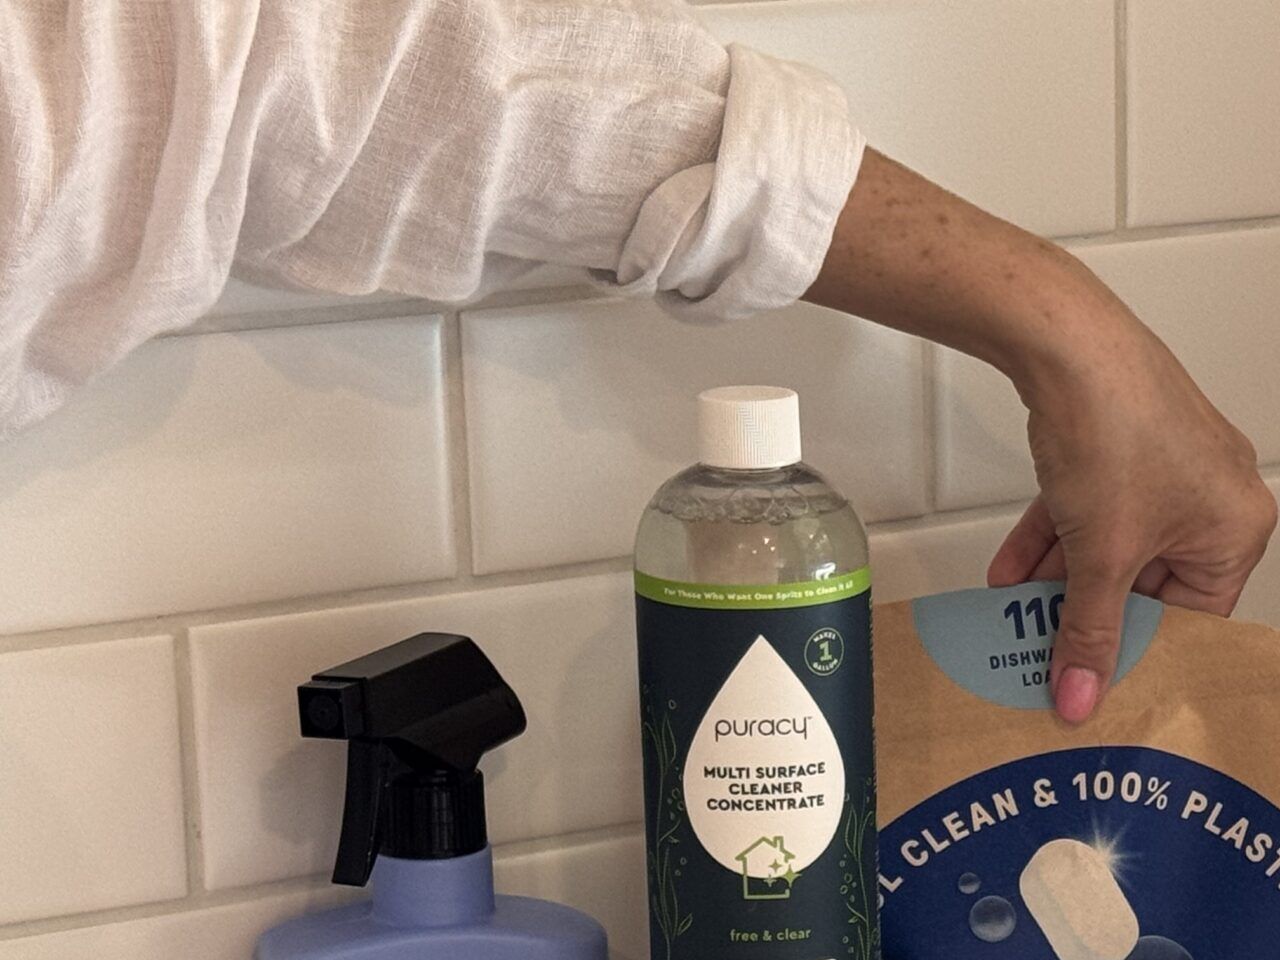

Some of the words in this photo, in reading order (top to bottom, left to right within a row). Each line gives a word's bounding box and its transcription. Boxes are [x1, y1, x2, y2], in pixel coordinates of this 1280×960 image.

[678, 589, 701, 599] Those
[704, 591, 724, 600] Who
[727, 592, 751, 601] Want
[754, 592, 773, 600] One
[776, 590, 802, 601] Spritz
[805, 590, 815, 598] to
[816, 586, 837, 596] Clean
[819, 641, 832, 661] 1
[715, 717, 807, 742] puracy
[704, 766, 750, 779] MULTI
[756, 761, 826, 779] SURFACE
[728, 781, 803, 795] CLEANER
[706, 794, 825, 812] CONCENTRATE
[900, 788, 1019, 867] CLEAN
[1033, 778, 1058, 807] &
[1072, 771, 1171, 811] 100%
[730, 929, 758, 941] free
[763, 930, 772, 941] &
[776, 928, 812, 941] clear
